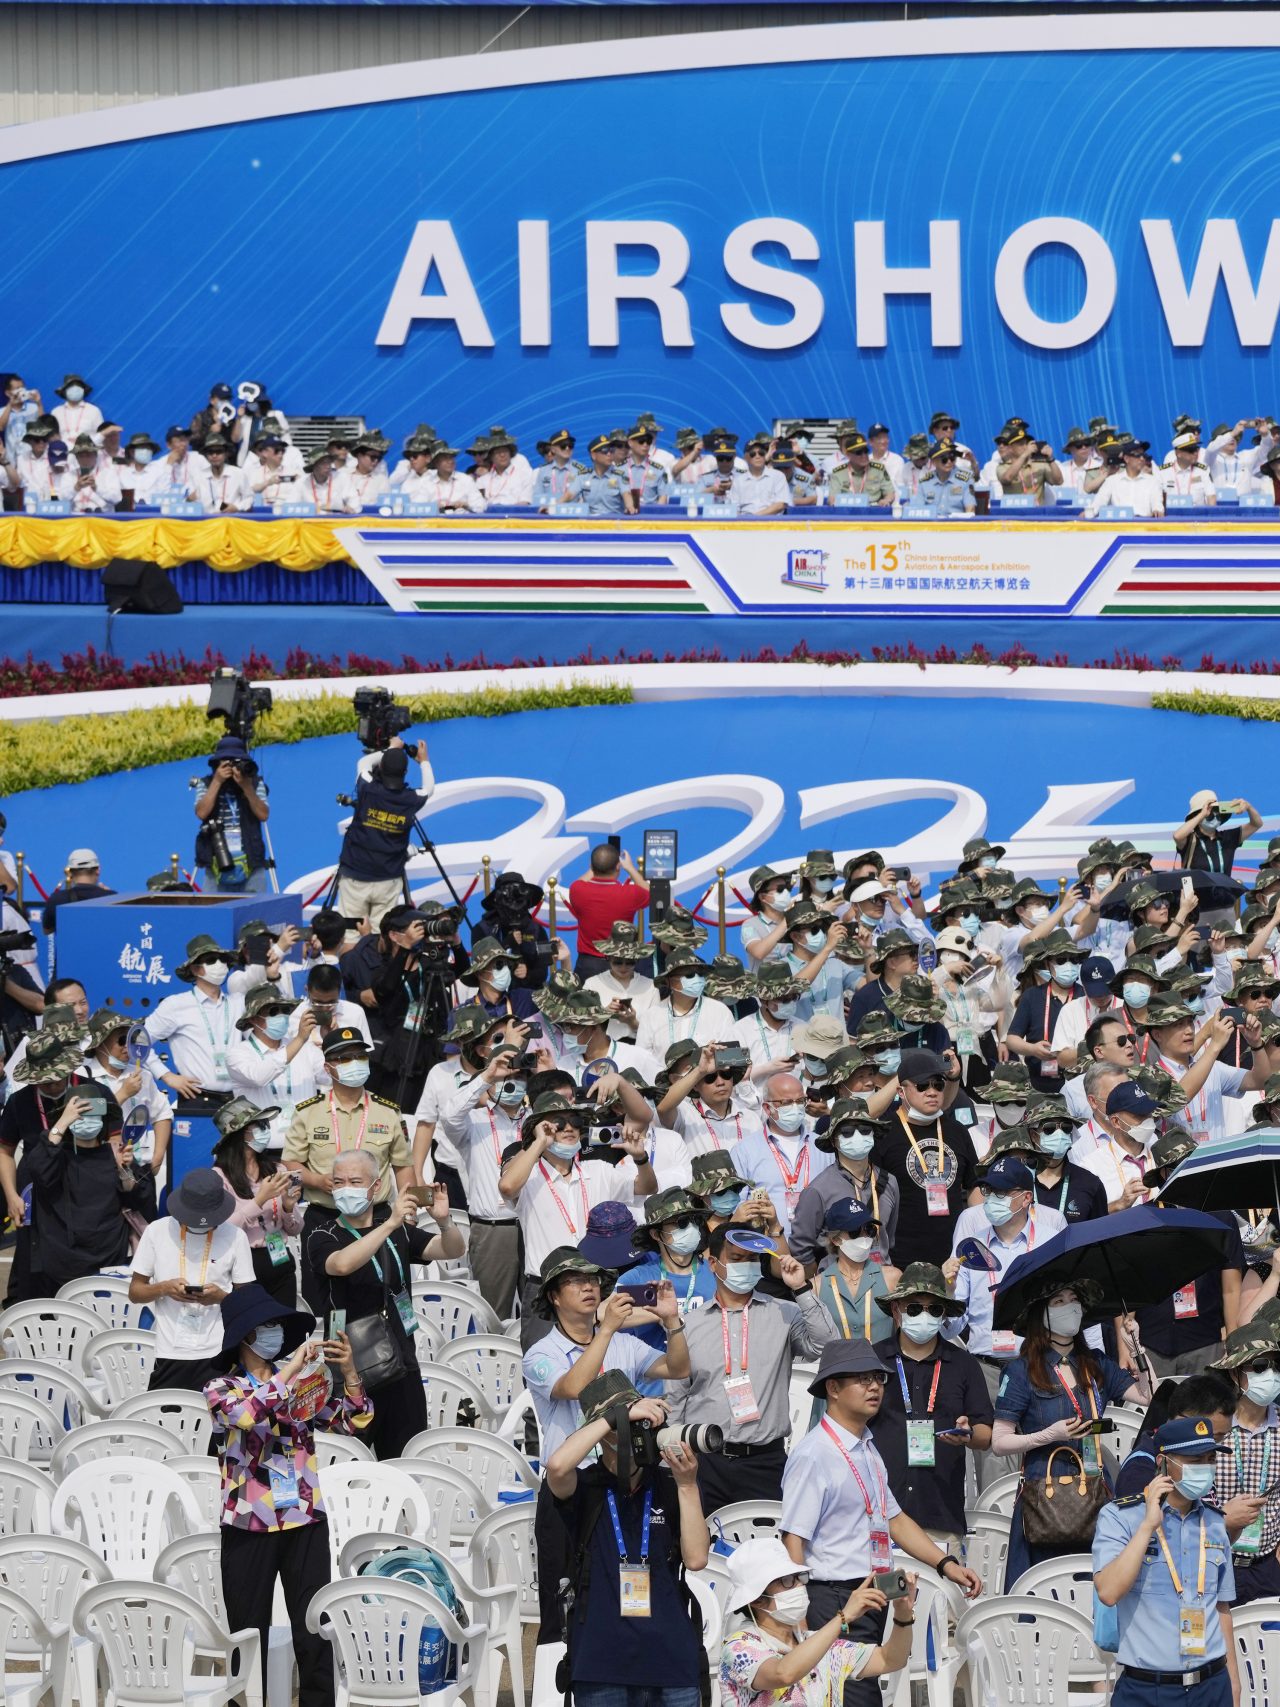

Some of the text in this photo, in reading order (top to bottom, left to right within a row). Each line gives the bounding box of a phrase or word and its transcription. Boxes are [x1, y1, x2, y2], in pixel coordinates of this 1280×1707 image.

[844, 558, 866, 571] The
[904, 554, 981, 562] China International
[904, 562, 1031, 573] Aviation & Aerospace Exhibition
[843, 577, 1032, 591] 第十三届中国国际航空航天博览会
[118, 943, 171, 985] 航展
